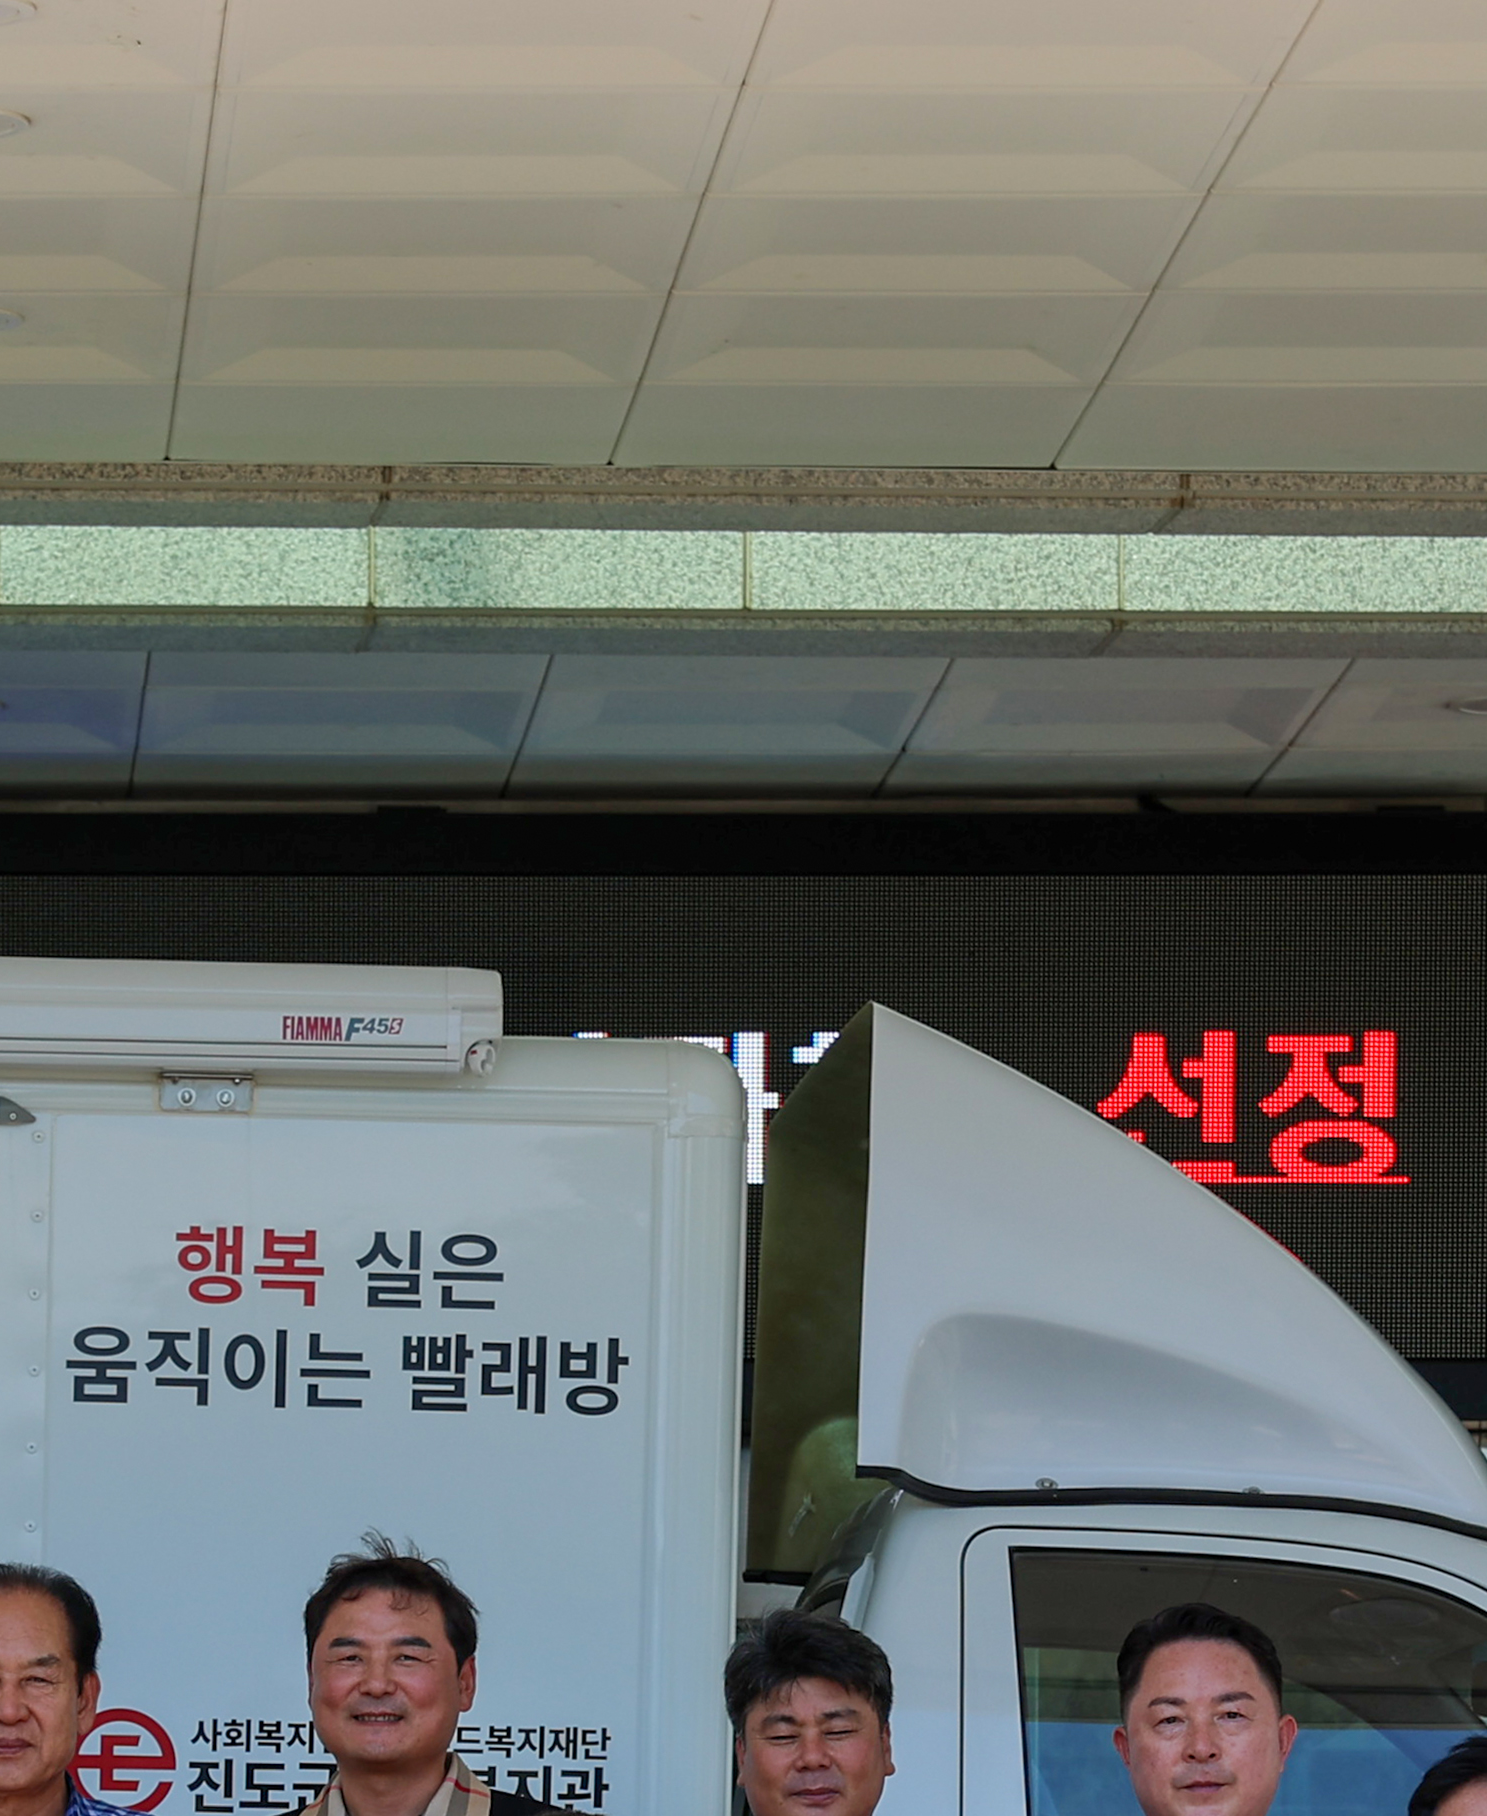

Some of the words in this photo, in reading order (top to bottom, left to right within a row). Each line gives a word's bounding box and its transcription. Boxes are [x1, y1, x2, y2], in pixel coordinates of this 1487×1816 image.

[282, 1015, 343, 1042] FIAMMA
[1096, 1030, 1402, 1184] 선정
[175, 1225, 326, 1309] 행복
[356, 1230, 505, 1313] 실은
[65, 1328, 372, 1409] 움직이는
[402, 1333, 630, 1416] 빨래방
